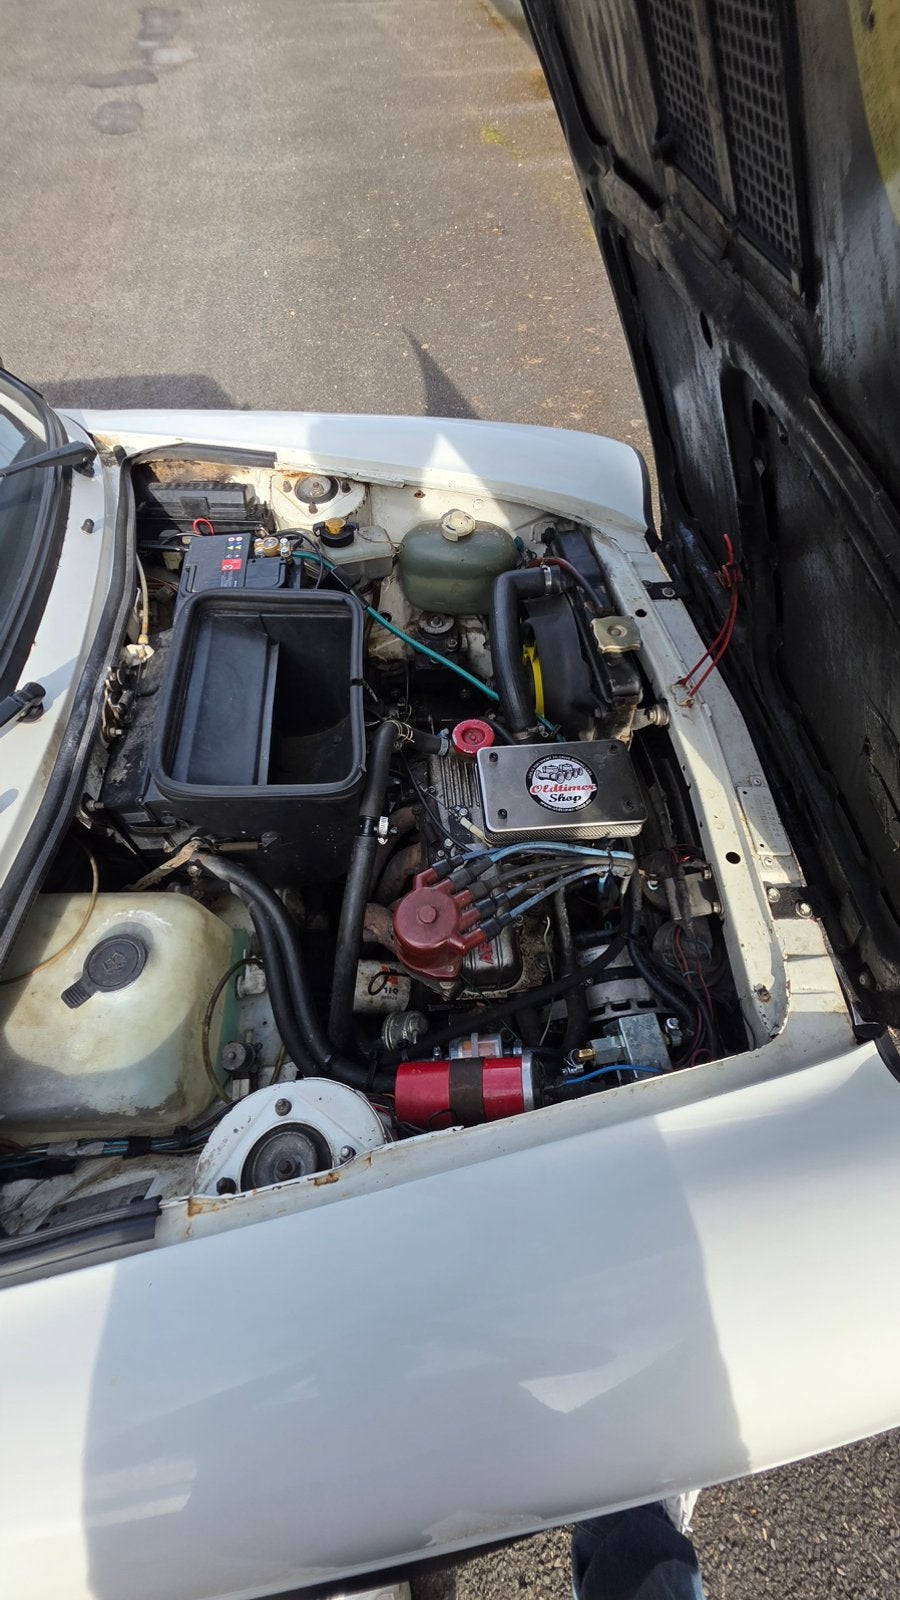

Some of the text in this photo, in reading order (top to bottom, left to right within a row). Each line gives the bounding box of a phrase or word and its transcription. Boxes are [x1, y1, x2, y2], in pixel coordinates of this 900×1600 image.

[530, 784, 596, 793] Oldtimer
[549, 793, 582, 803] Shop
[383, 987, 399, 995] OIL
